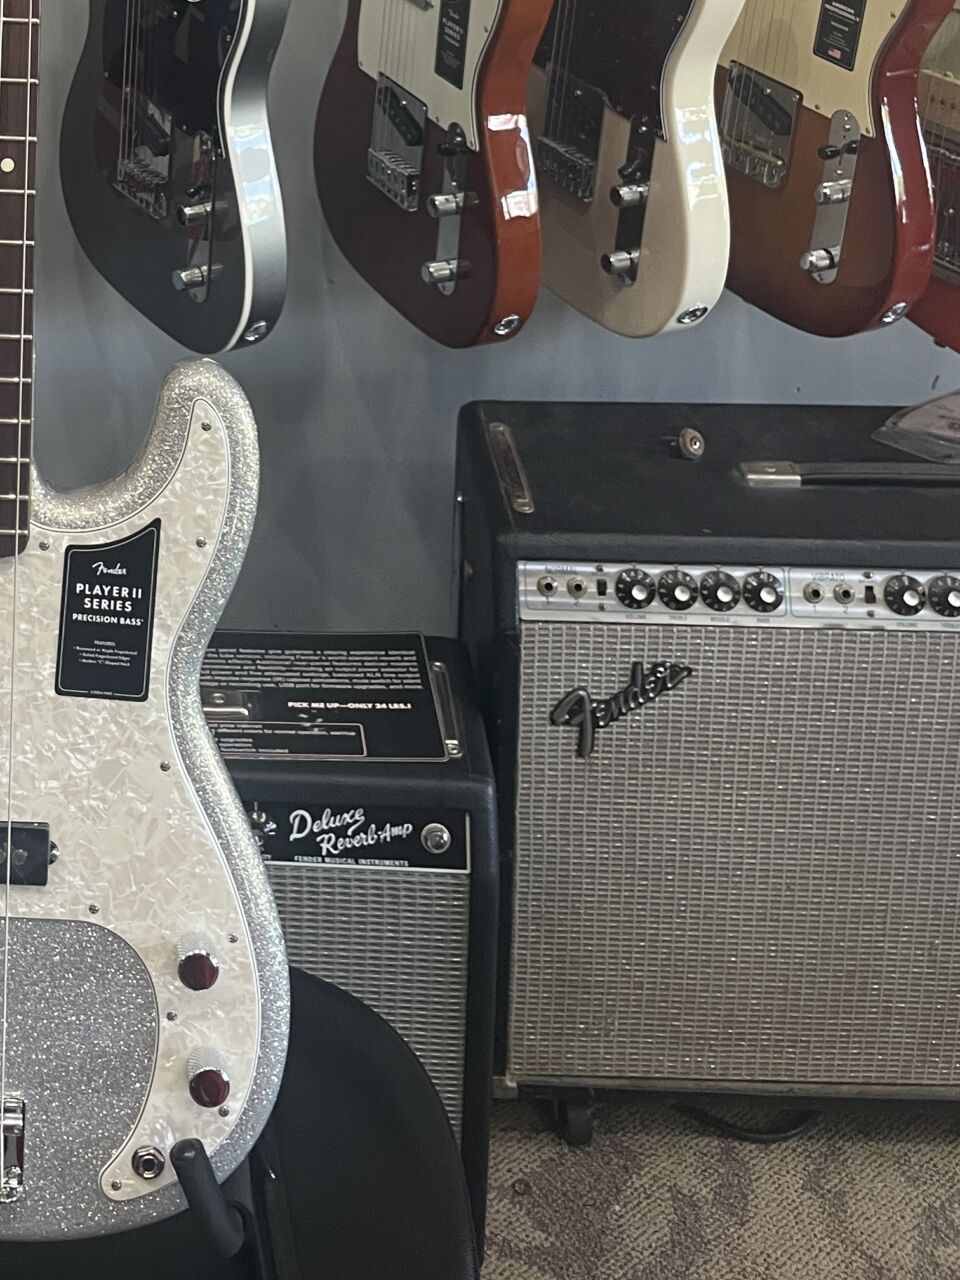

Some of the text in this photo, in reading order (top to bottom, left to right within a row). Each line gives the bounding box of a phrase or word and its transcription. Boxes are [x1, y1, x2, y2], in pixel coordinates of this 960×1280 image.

[92, 561, 127, 575] Fender
[84, 598, 132, 612] SERIES
[72, 613, 118, 624] PRECISION
[550, 660, 692, 757] Fender
[290, 808, 365, 841] Deluxe
[294, 855, 409, 867] FENDER MUSICAL INSTRUMENTS
